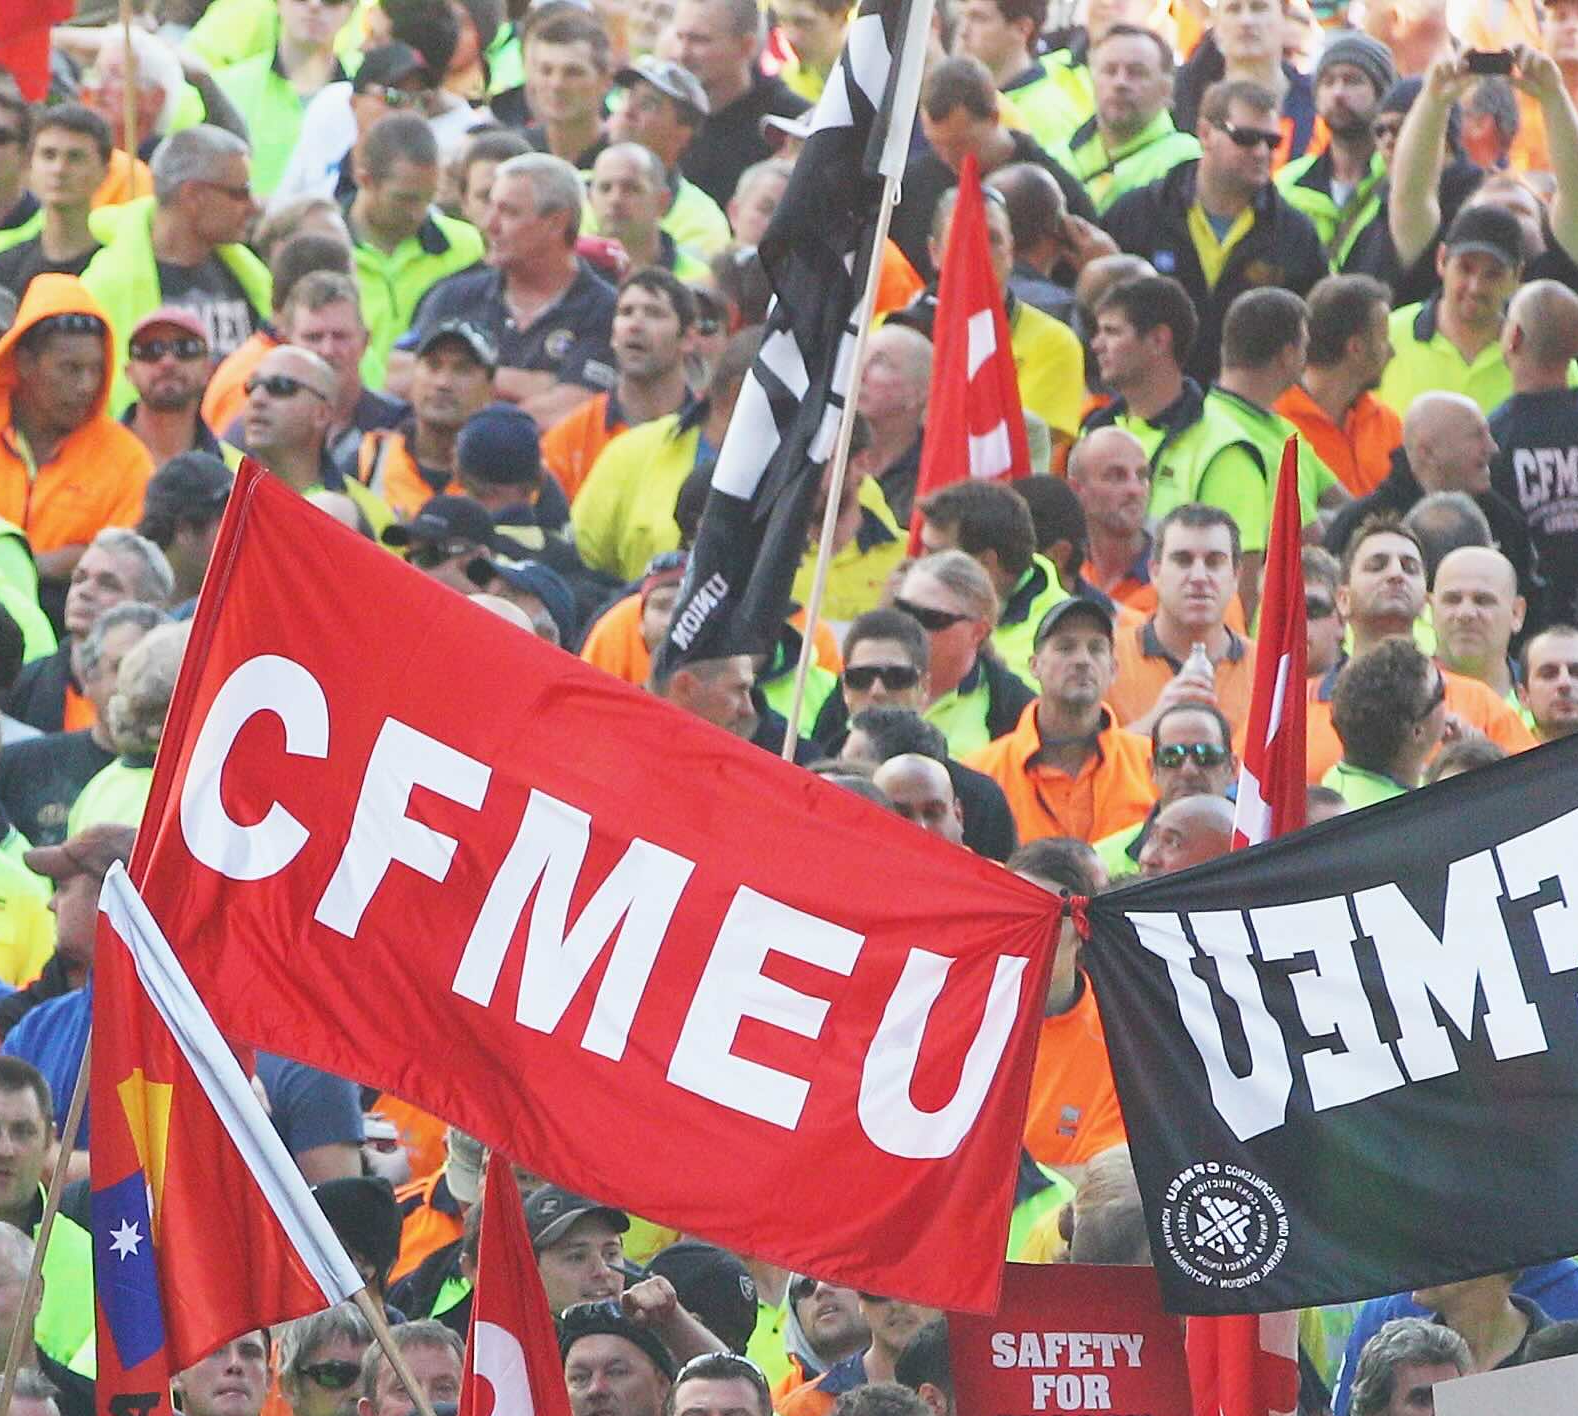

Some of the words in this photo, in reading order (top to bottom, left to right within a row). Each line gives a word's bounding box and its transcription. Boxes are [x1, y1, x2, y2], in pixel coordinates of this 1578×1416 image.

[179, 653, 1028, 1159] CFMEU
[990, 1332, 1144, 1369] SAFETY
[1031, 1373, 1112, 1410] FOR
